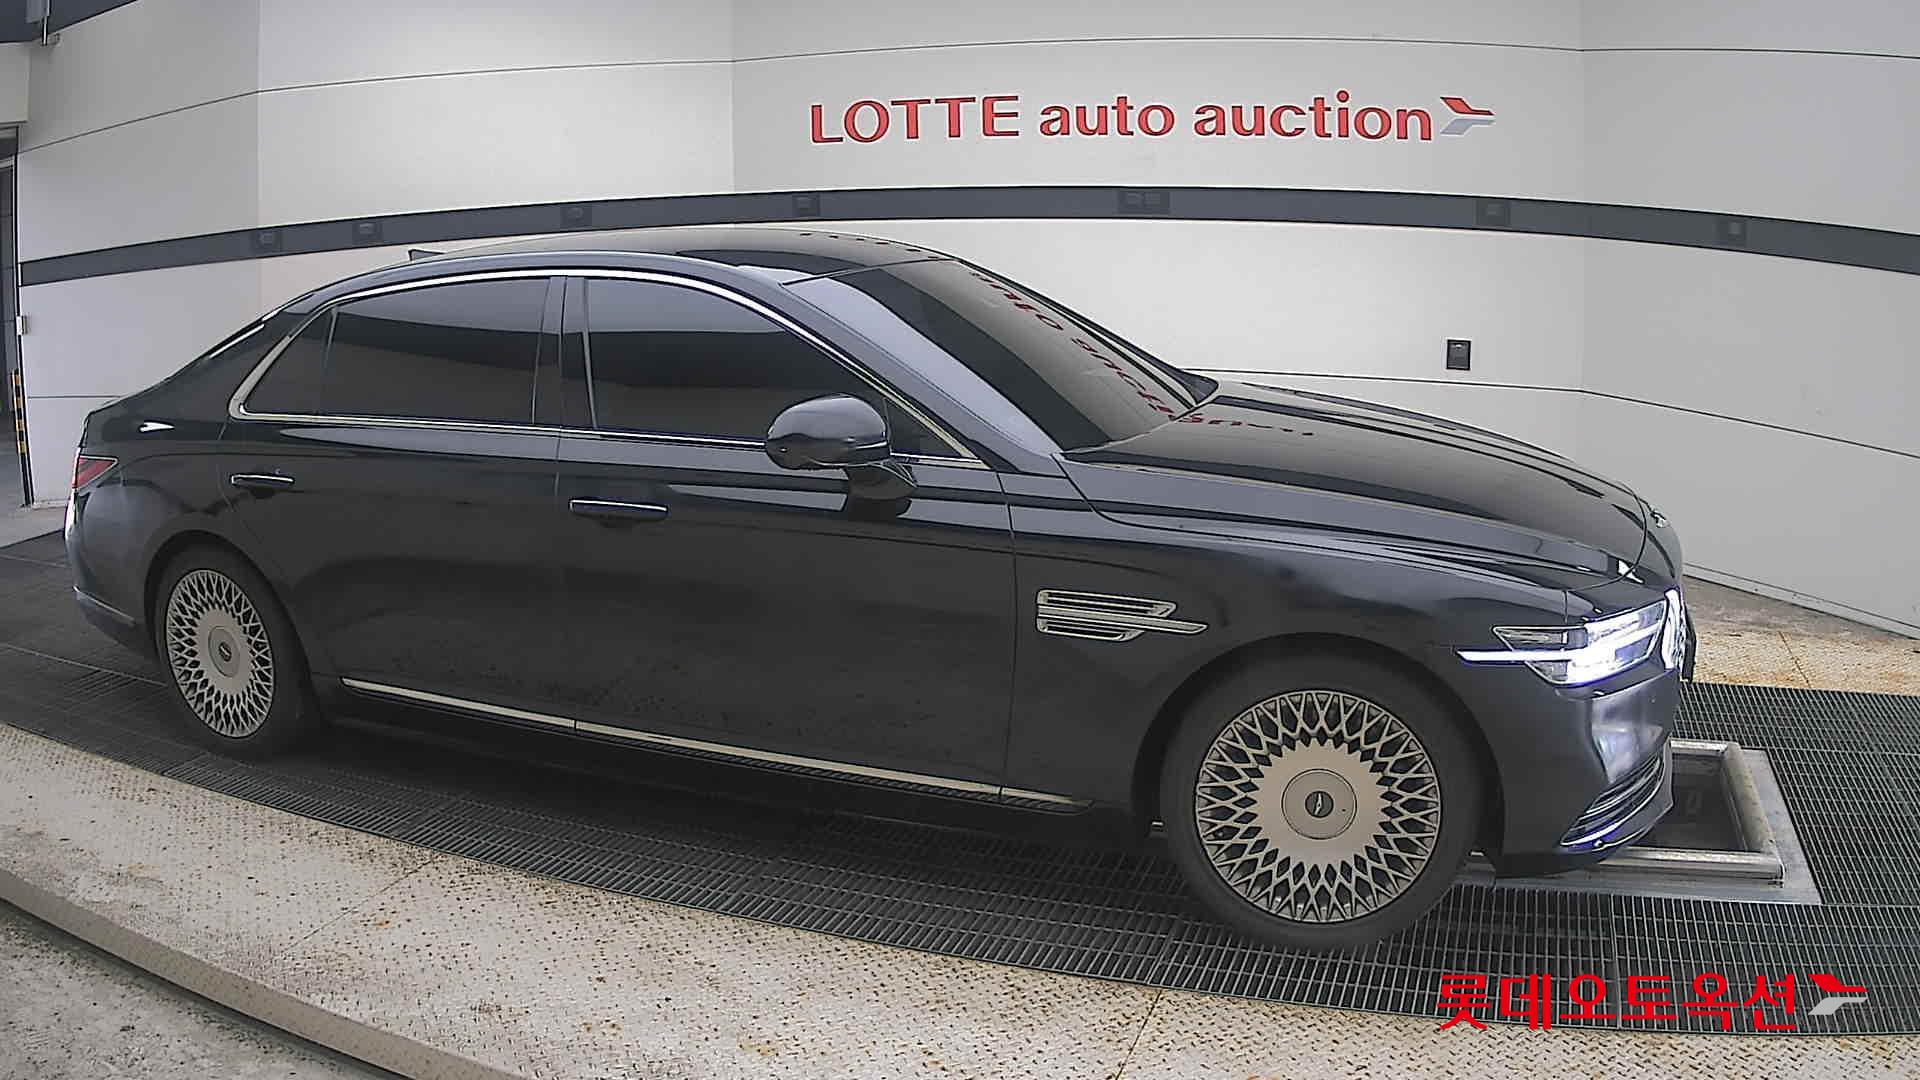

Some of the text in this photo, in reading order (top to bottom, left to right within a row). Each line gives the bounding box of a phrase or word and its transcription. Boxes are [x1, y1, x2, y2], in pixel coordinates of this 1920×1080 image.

[811, 90, 1432, 143] LOTTE auto auction
